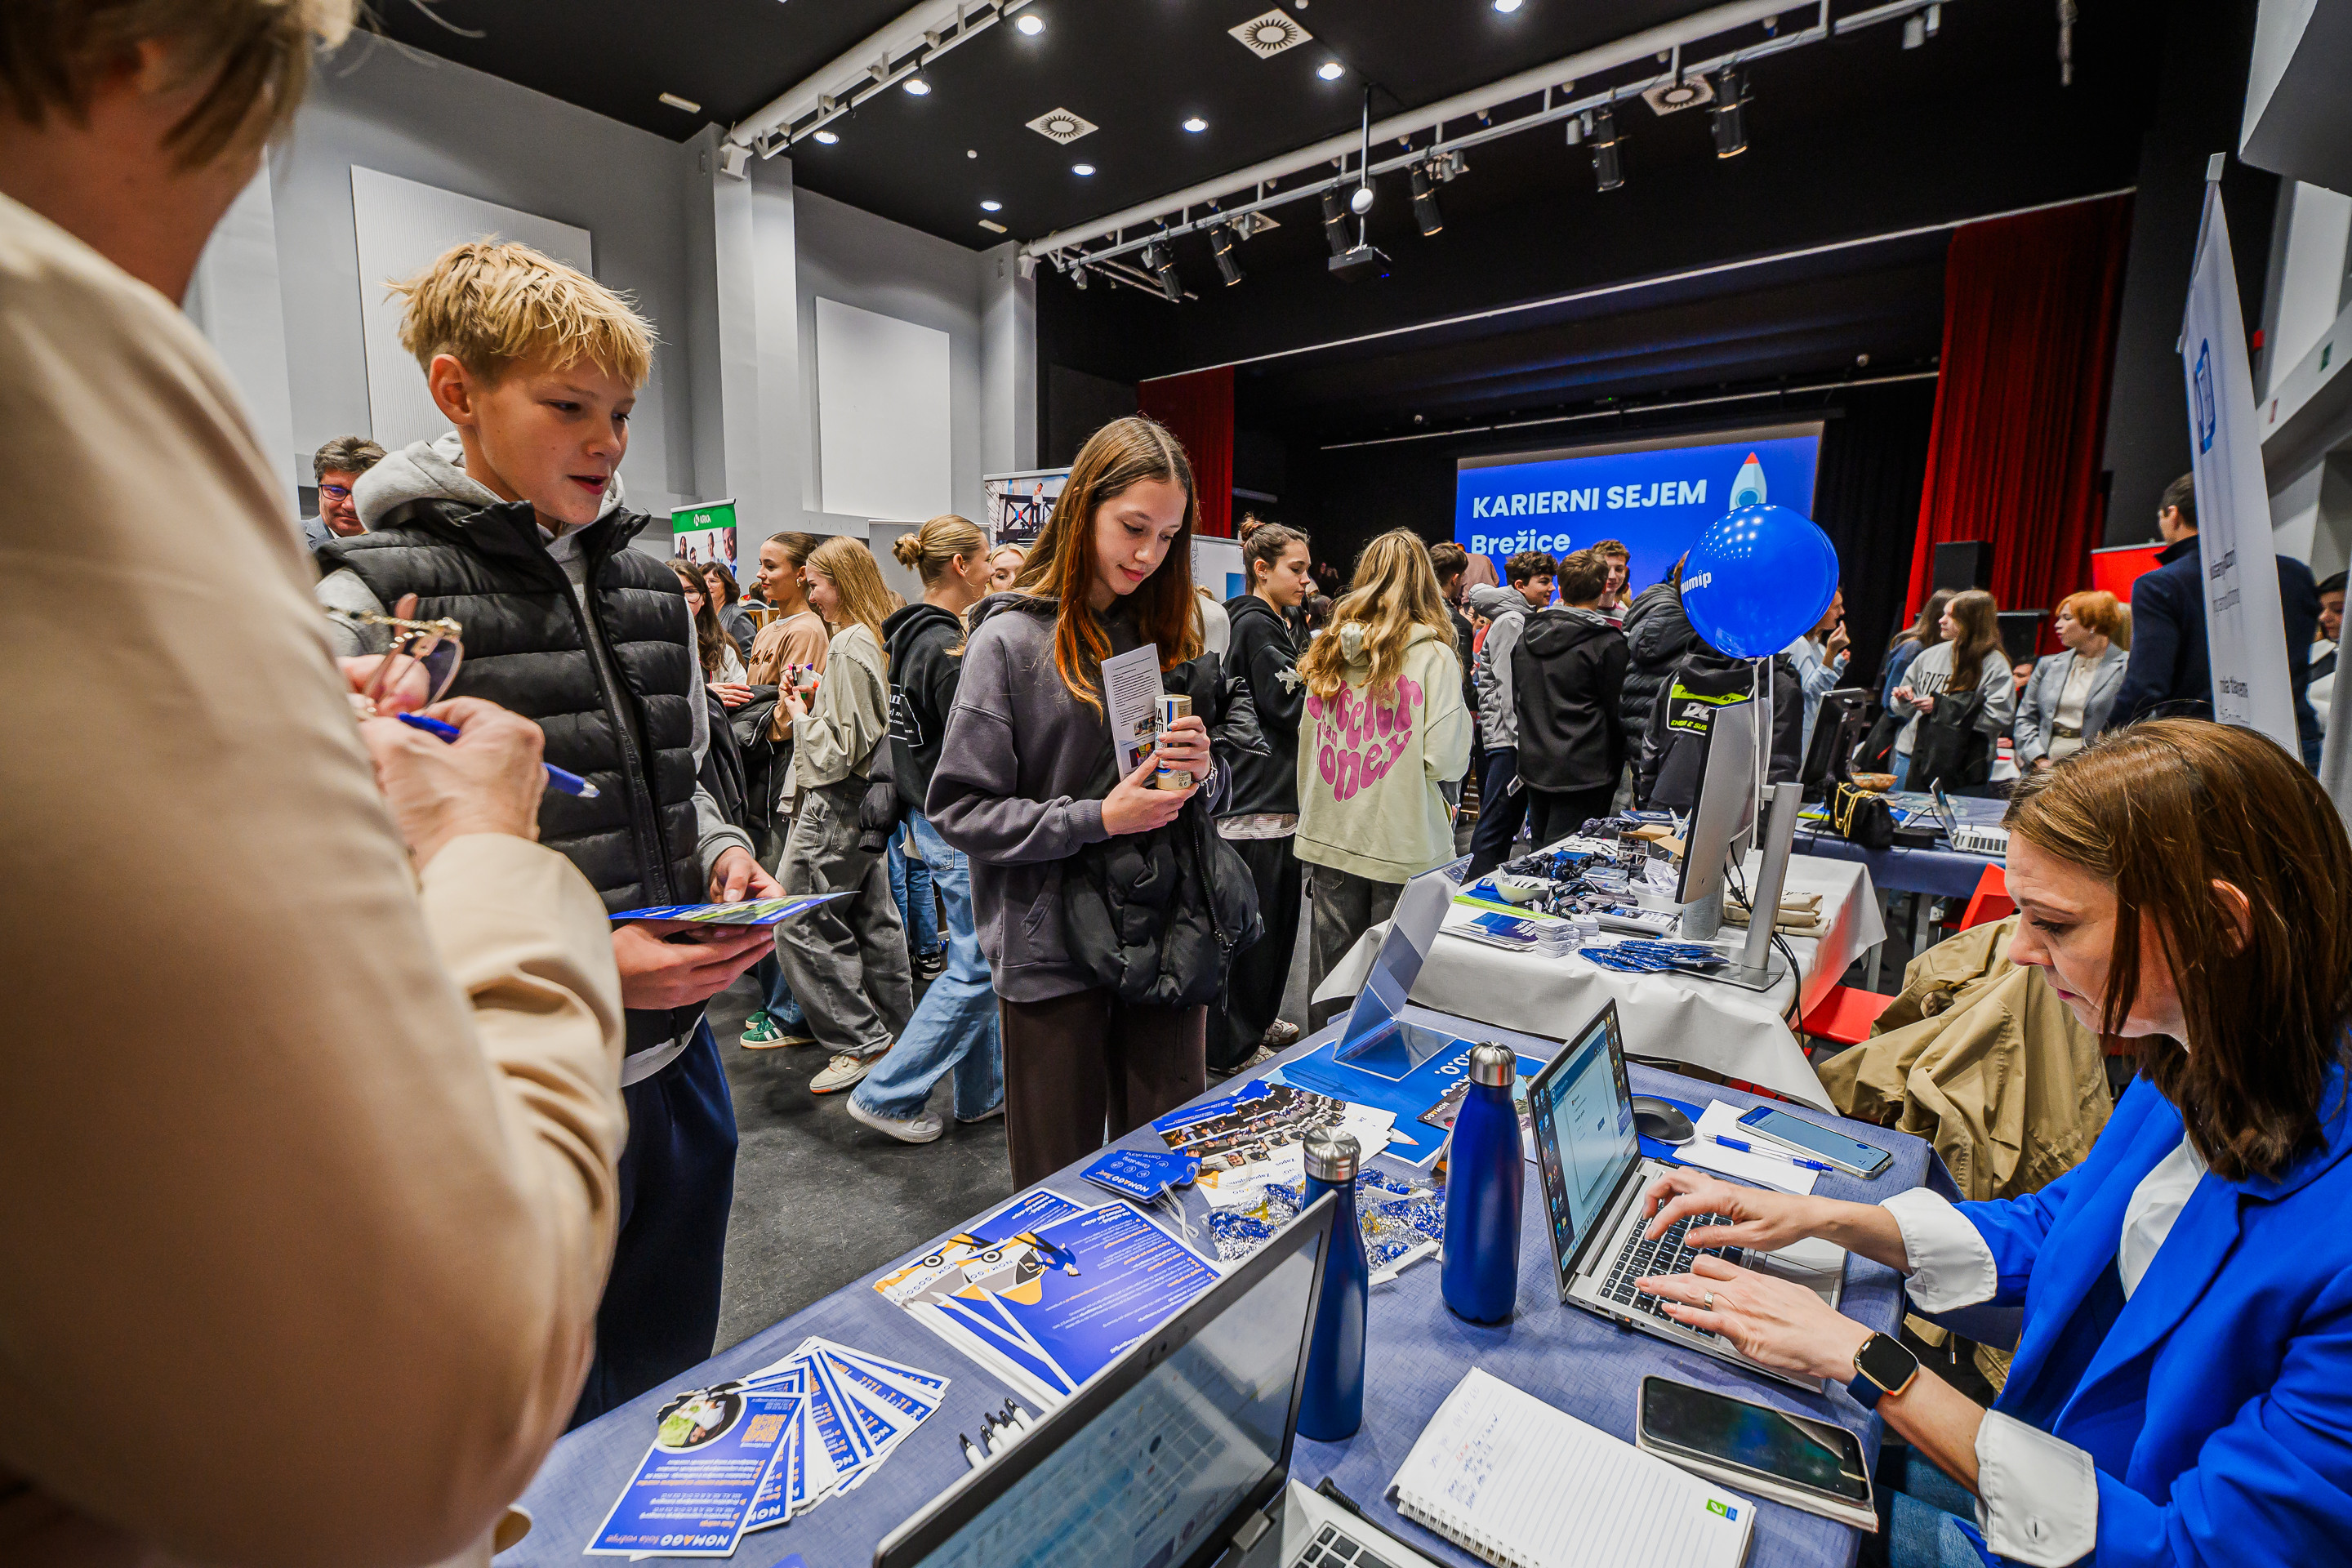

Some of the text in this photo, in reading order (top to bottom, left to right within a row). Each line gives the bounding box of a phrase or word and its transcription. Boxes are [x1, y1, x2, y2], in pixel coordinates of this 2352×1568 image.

[1472, 479, 1708, 519] KARIERNI SEJEM
[1471, 529, 1571, 555] Brežice
[1423, 1102, 1450, 1121] NOMAGO
[1112, 1176, 1150, 1193] NOMAGO
[661, 1533, 730, 1548] NOMAGO
